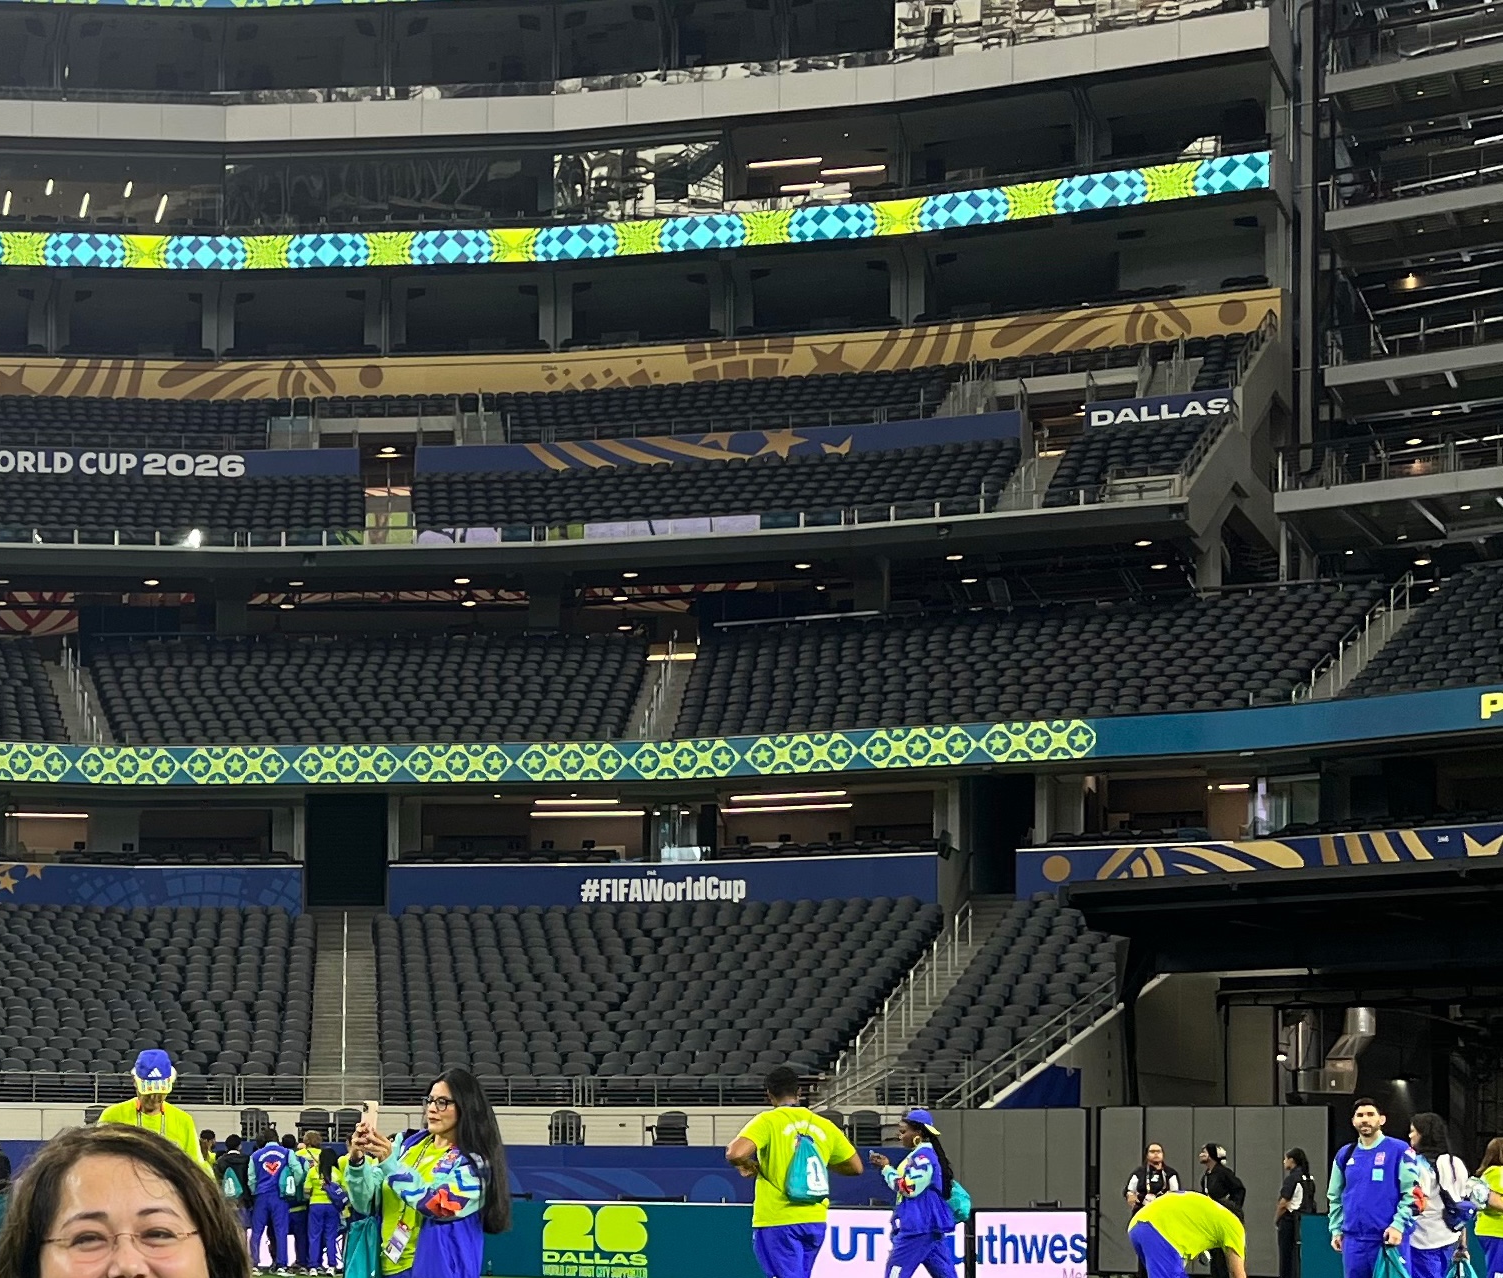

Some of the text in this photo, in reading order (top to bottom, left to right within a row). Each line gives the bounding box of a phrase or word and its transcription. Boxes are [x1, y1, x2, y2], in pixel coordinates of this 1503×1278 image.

[1090, 398, 1231, 427] DALLAS
[78, 452, 138, 476] CUP
[142, 453, 246, 478] 2026
[580, 876, 747, 903] #FIFAWorldCup
[543, 1204, 648, 1253] 26
[831, 1225, 884, 1262] UT
[542, 1251, 648, 1266] DALLAS
